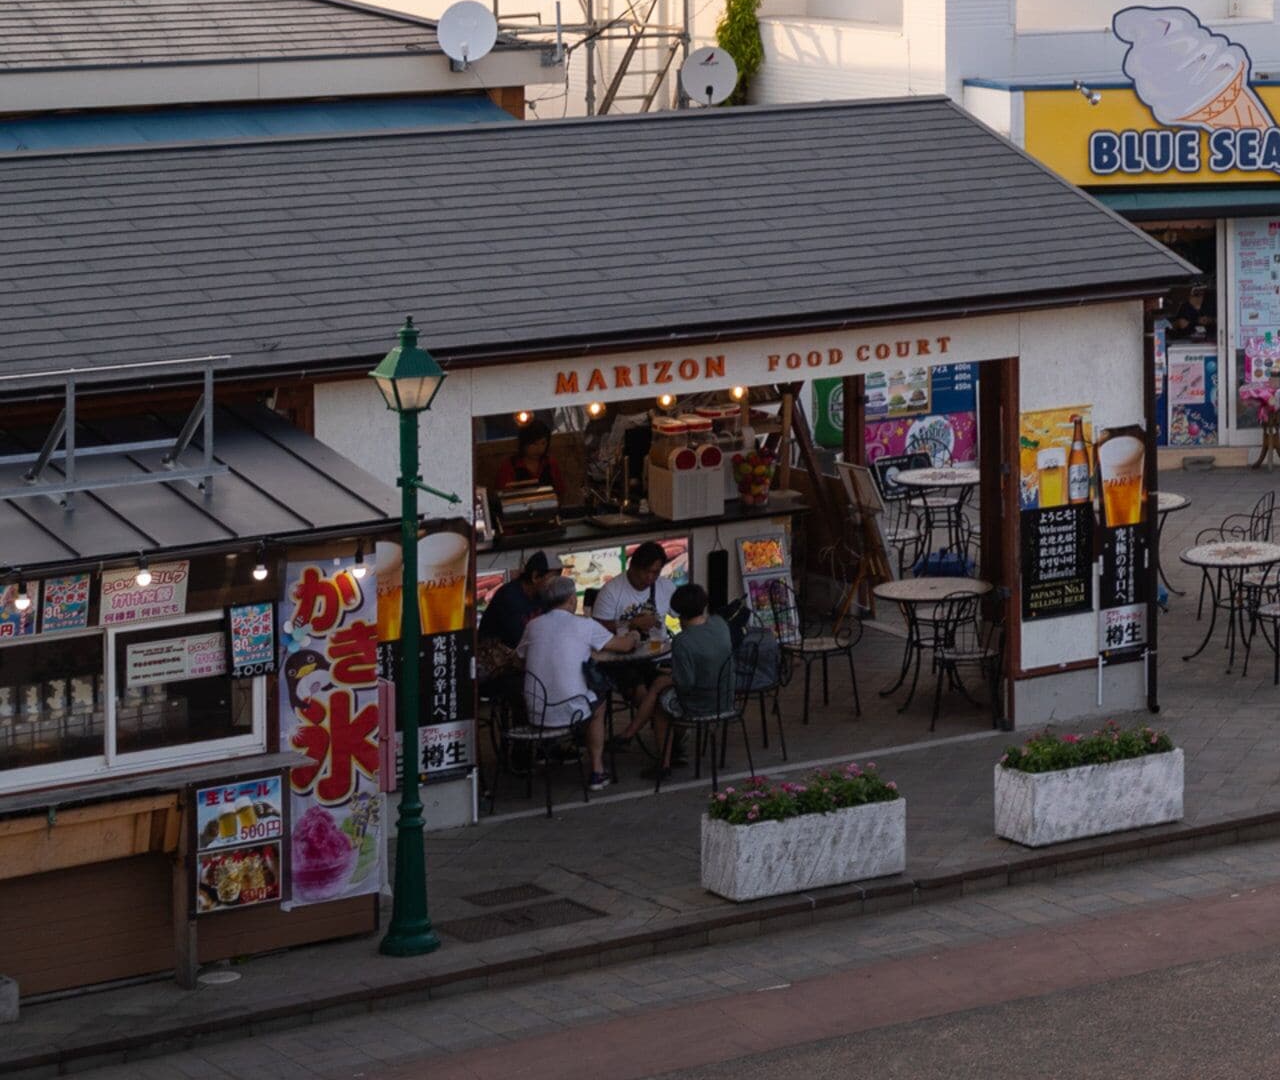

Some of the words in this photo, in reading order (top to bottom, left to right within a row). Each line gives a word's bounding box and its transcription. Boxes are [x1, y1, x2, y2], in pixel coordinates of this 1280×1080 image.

[1090, 130, 1200, 174] BLUE
[555, 355, 726, 395] MARIZON
[768, 348, 843, 373] FOOD
[856, 336, 952, 361] COURT
[103, 570, 186, 595] シロッミルク
[1106, 622, 1142, 647] 樽生
[290, 565, 378, 806] かき氷
[421, 741, 469, 769] 樽生
[206, 783, 270, 807] 生ビール
[240, 820, 281, 840] 500円
